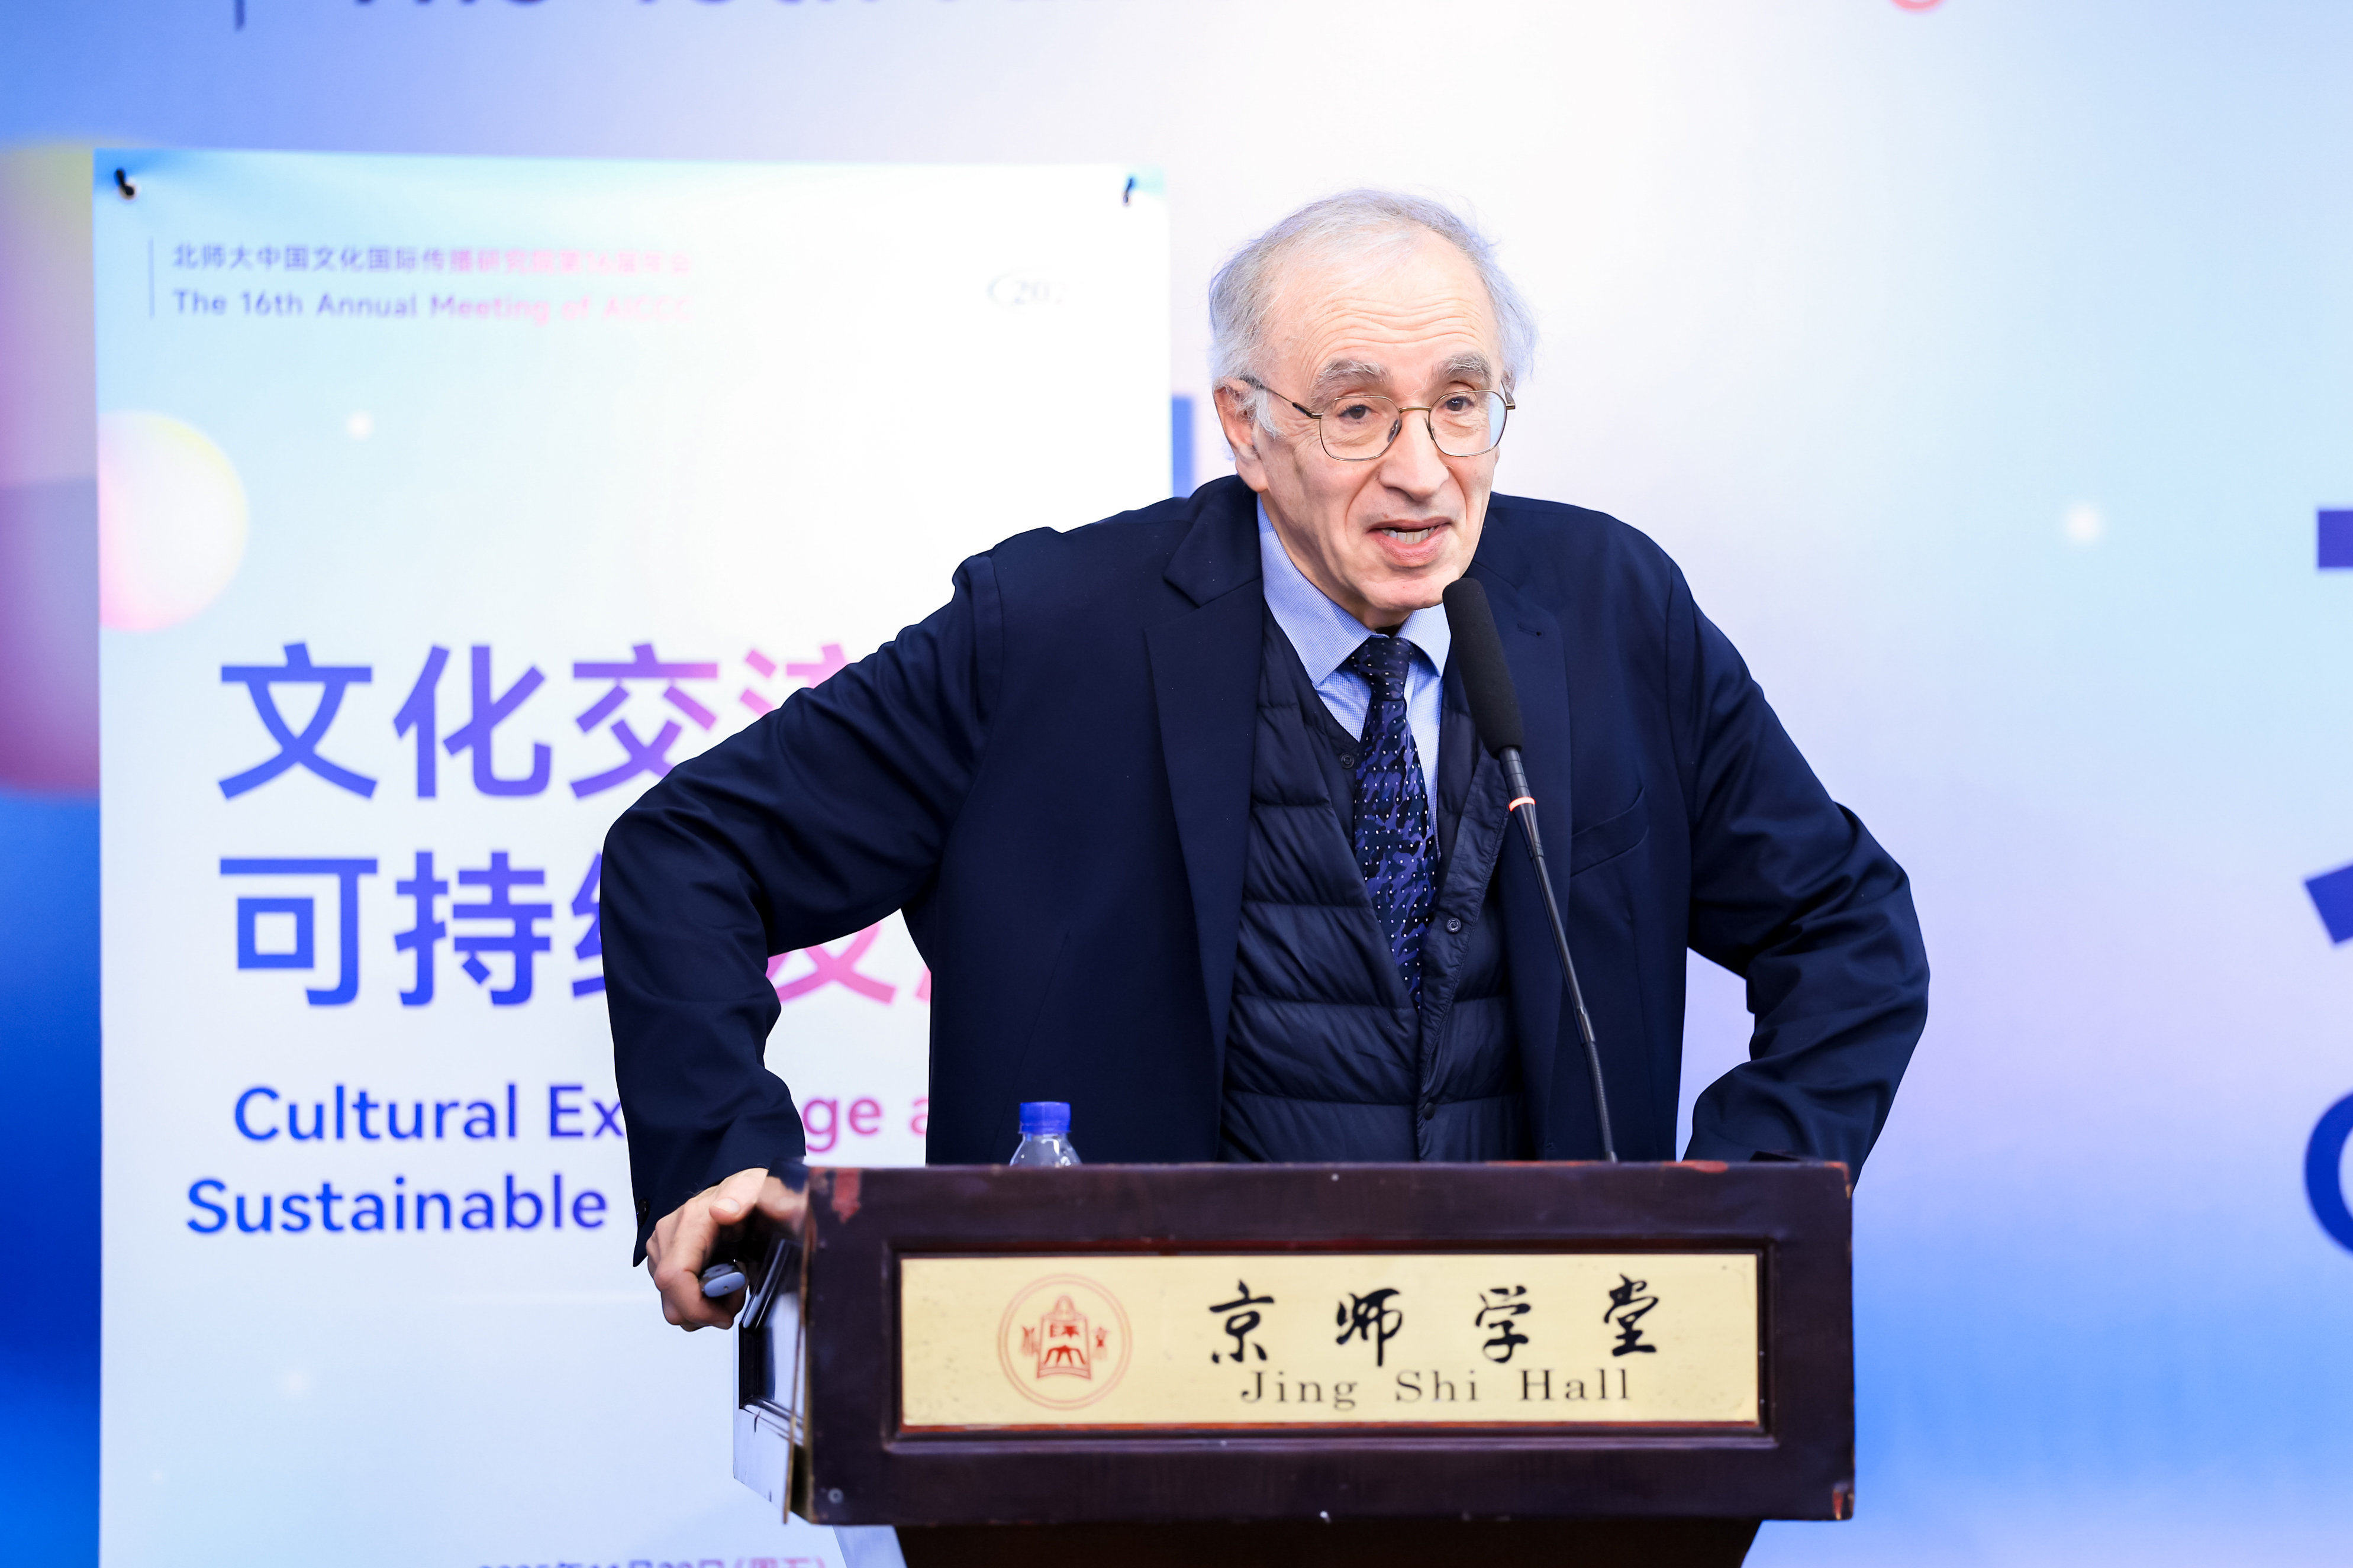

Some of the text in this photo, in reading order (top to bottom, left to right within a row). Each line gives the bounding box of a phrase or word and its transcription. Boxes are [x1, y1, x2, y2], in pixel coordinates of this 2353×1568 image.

[173, 289, 227, 316] The
[241, 290, 304, 317] 16th
[316, 292, 418, 318] Annual
[429, 293, 549, 325] Meeting
[560, 293, 592, 322] of
[234, 1083, 517, 1142] Cultural
[187, 1173, 607, 1234] Sustainable
[1240, 1368, 1629, 1411] Jing Shi Hall
